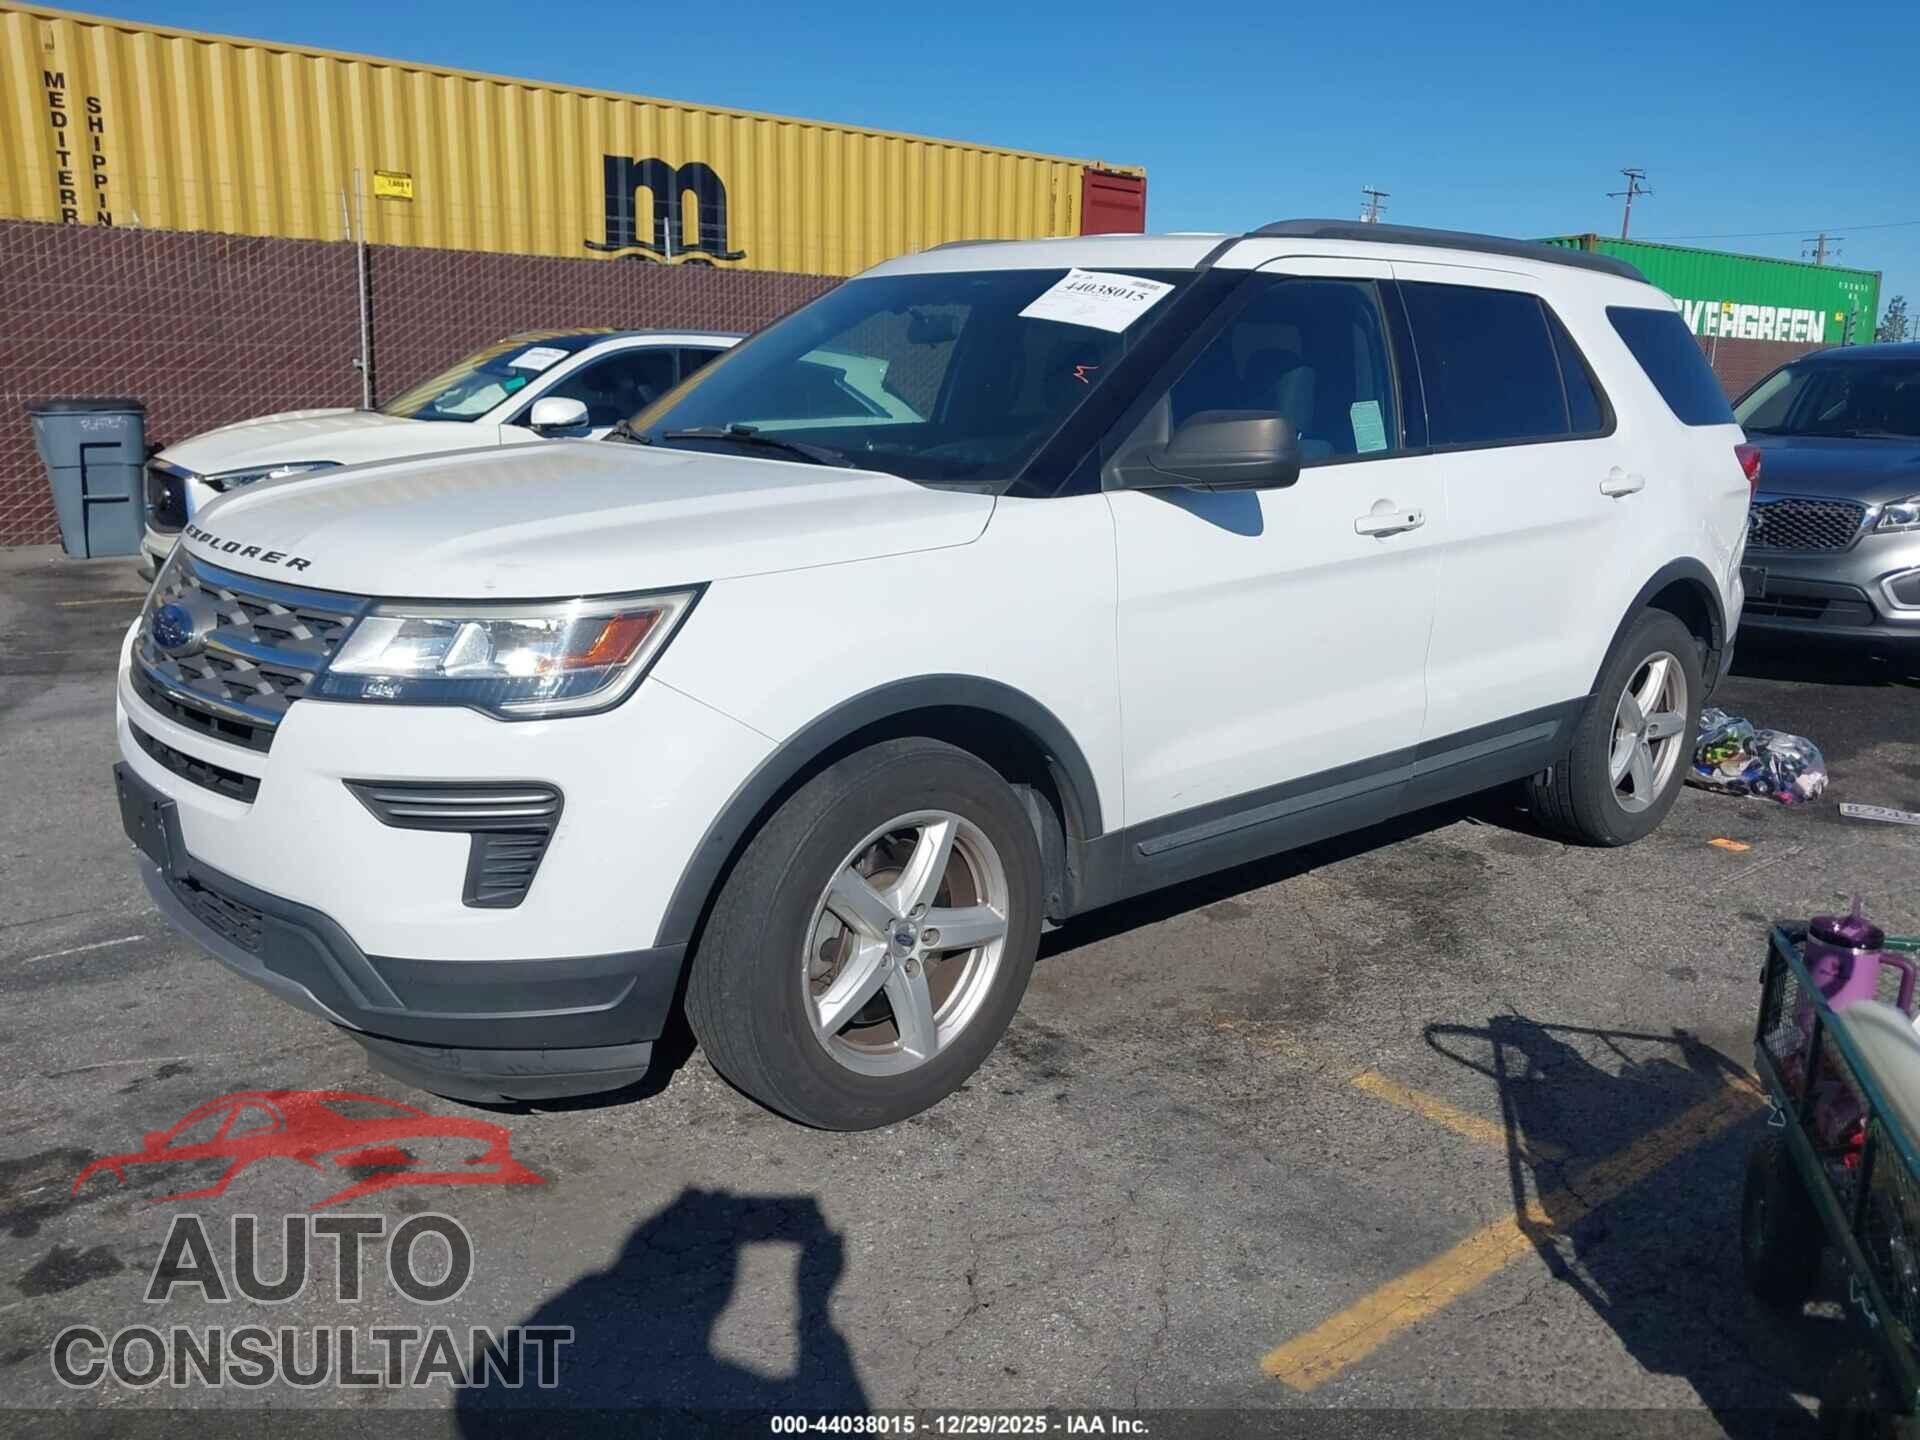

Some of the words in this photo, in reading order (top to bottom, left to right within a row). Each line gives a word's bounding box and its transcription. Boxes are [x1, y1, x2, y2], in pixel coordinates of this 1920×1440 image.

[1065, 280, 1150, 302] 44038015
[1674, 298, 1826, 343] VERGREEN
[186, 524, 312, 572] EXPLORER
